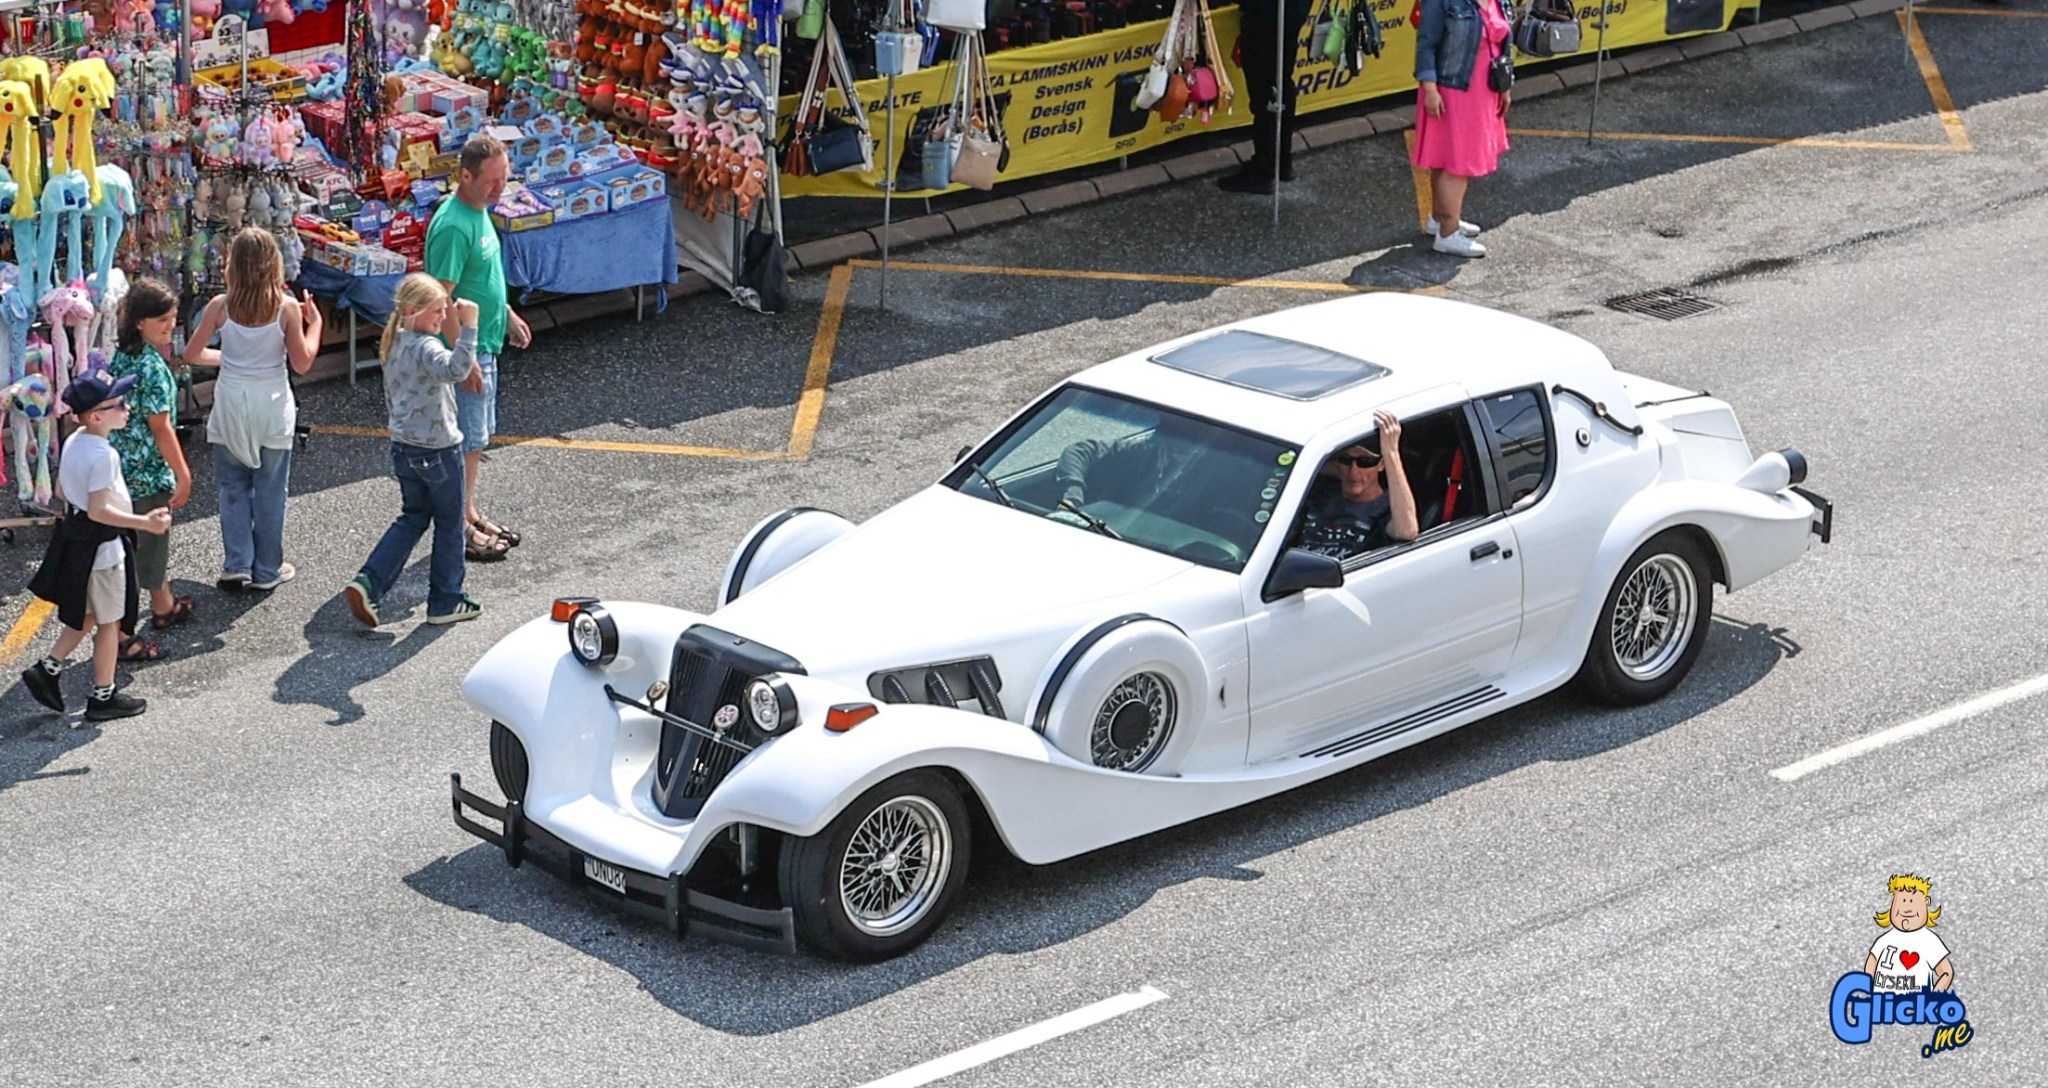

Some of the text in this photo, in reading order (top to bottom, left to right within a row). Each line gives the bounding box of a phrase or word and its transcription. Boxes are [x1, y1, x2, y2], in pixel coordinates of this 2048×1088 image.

[1576, 0, 1628, 19] (Boås)
[1009, 54, 1108, 85] LAMMSKINN
[1294, 66, 1353, 96] RFID
[1034, 76, 1095, 99] Svensk
[1030, 99, 1086, 120] Design
[1022, 116, 1083, 144] (Borås)
[1114, 137, 1136, 151] RFID
